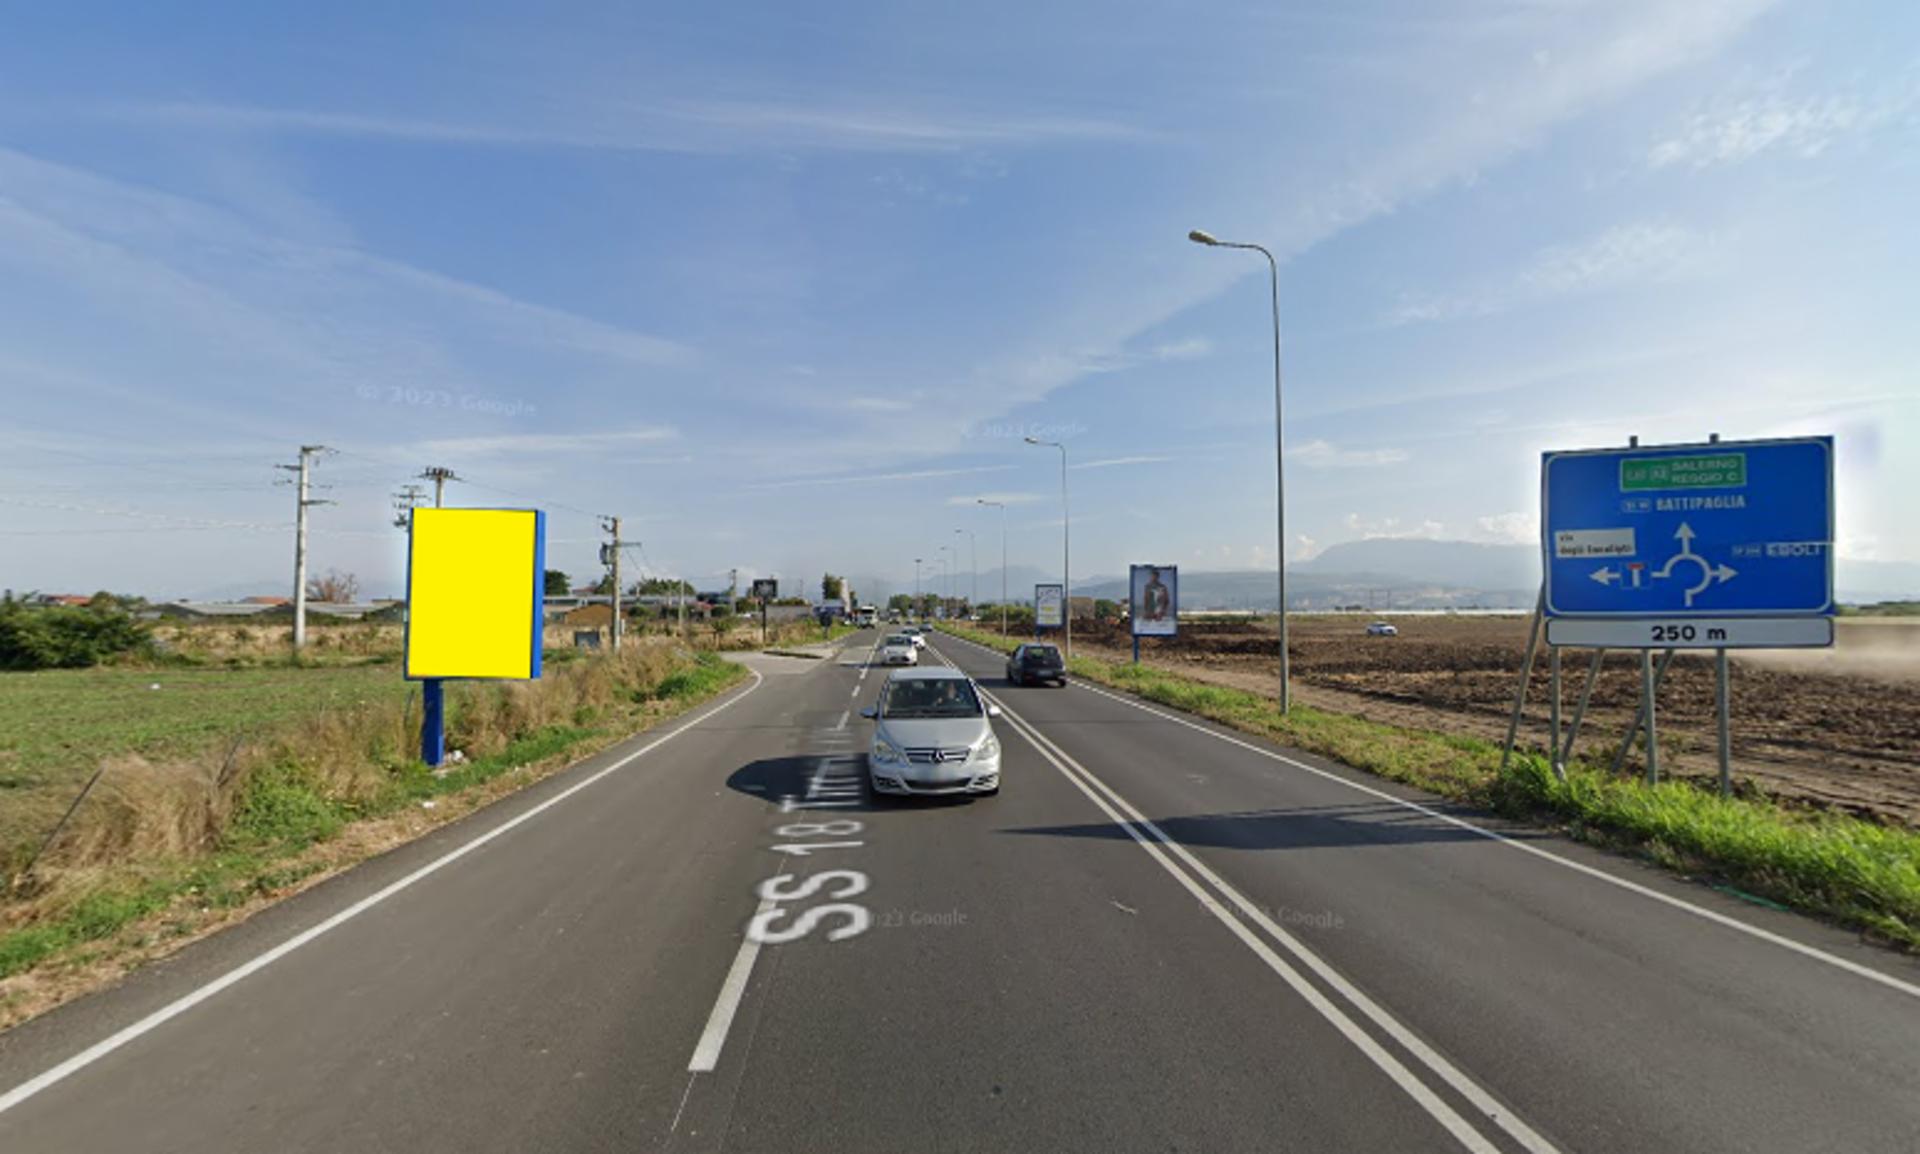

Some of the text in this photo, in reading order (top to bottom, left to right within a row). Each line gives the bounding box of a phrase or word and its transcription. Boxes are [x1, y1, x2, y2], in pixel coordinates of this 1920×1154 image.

[1671, 459, 1738, 471] SALERNO
[1656, 495, 1745, 511] BATTIPAGLIA
[1651, 626, 1726, 641] 250 m
